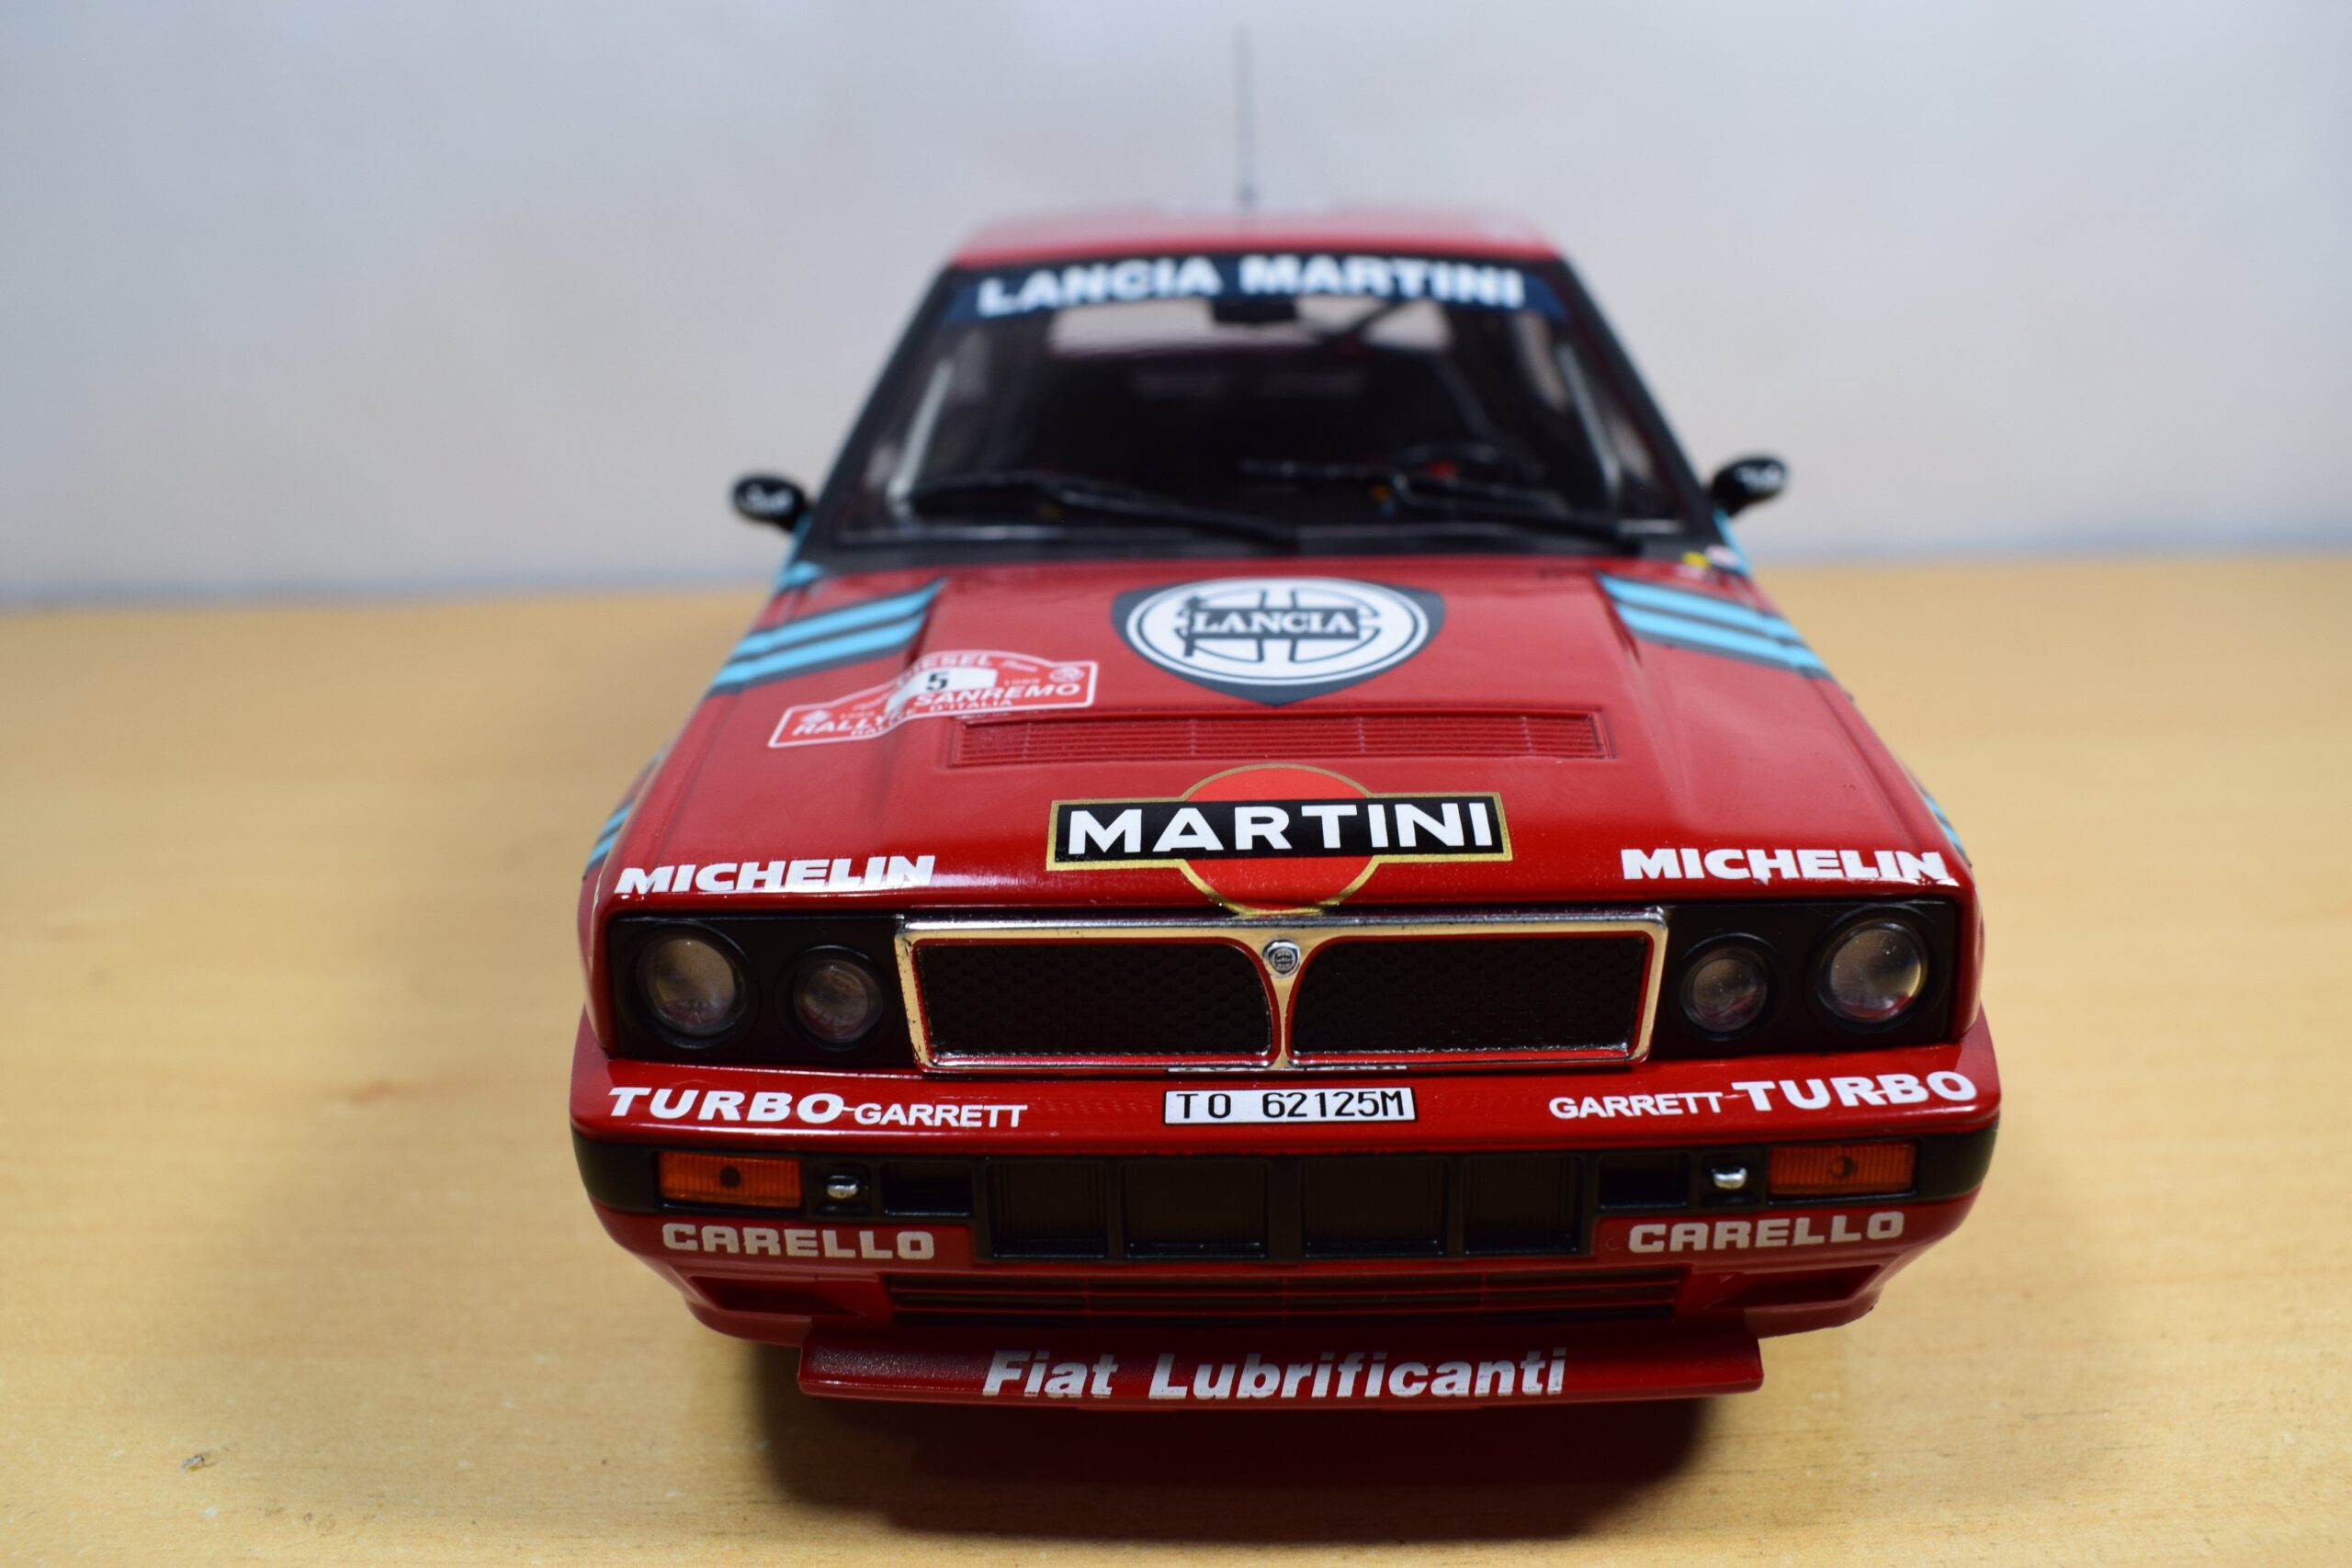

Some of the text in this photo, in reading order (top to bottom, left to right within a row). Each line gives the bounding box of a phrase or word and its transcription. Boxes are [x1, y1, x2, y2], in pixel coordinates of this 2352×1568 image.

[976, 254, 1525, 317] LANCIA MARTINI
[1191, 612, 1357, 634] LANCIA
[913, 682, 1081, 707] SANREMO
[926, 671, 951, 691] 5
[1069, 802, 1492, 854] MARTINI
[614, 855, 935, 894] MICHELIN
[1620, 848, 1950, 880] MICHELIN
[608, 1087, 1028, 1128] TURBO GARRETT
[1176, 1090, 1404, 1119] TO 62125M
[1549, 1071, 1976, 1120] GARRETT TURBO
[662, 1223, 934, 1259] CARELLO
[1629, 1211, 1905, 1254] CARELLO
[982, 1347, 1567, 1399] Fiat Lubrificanti
